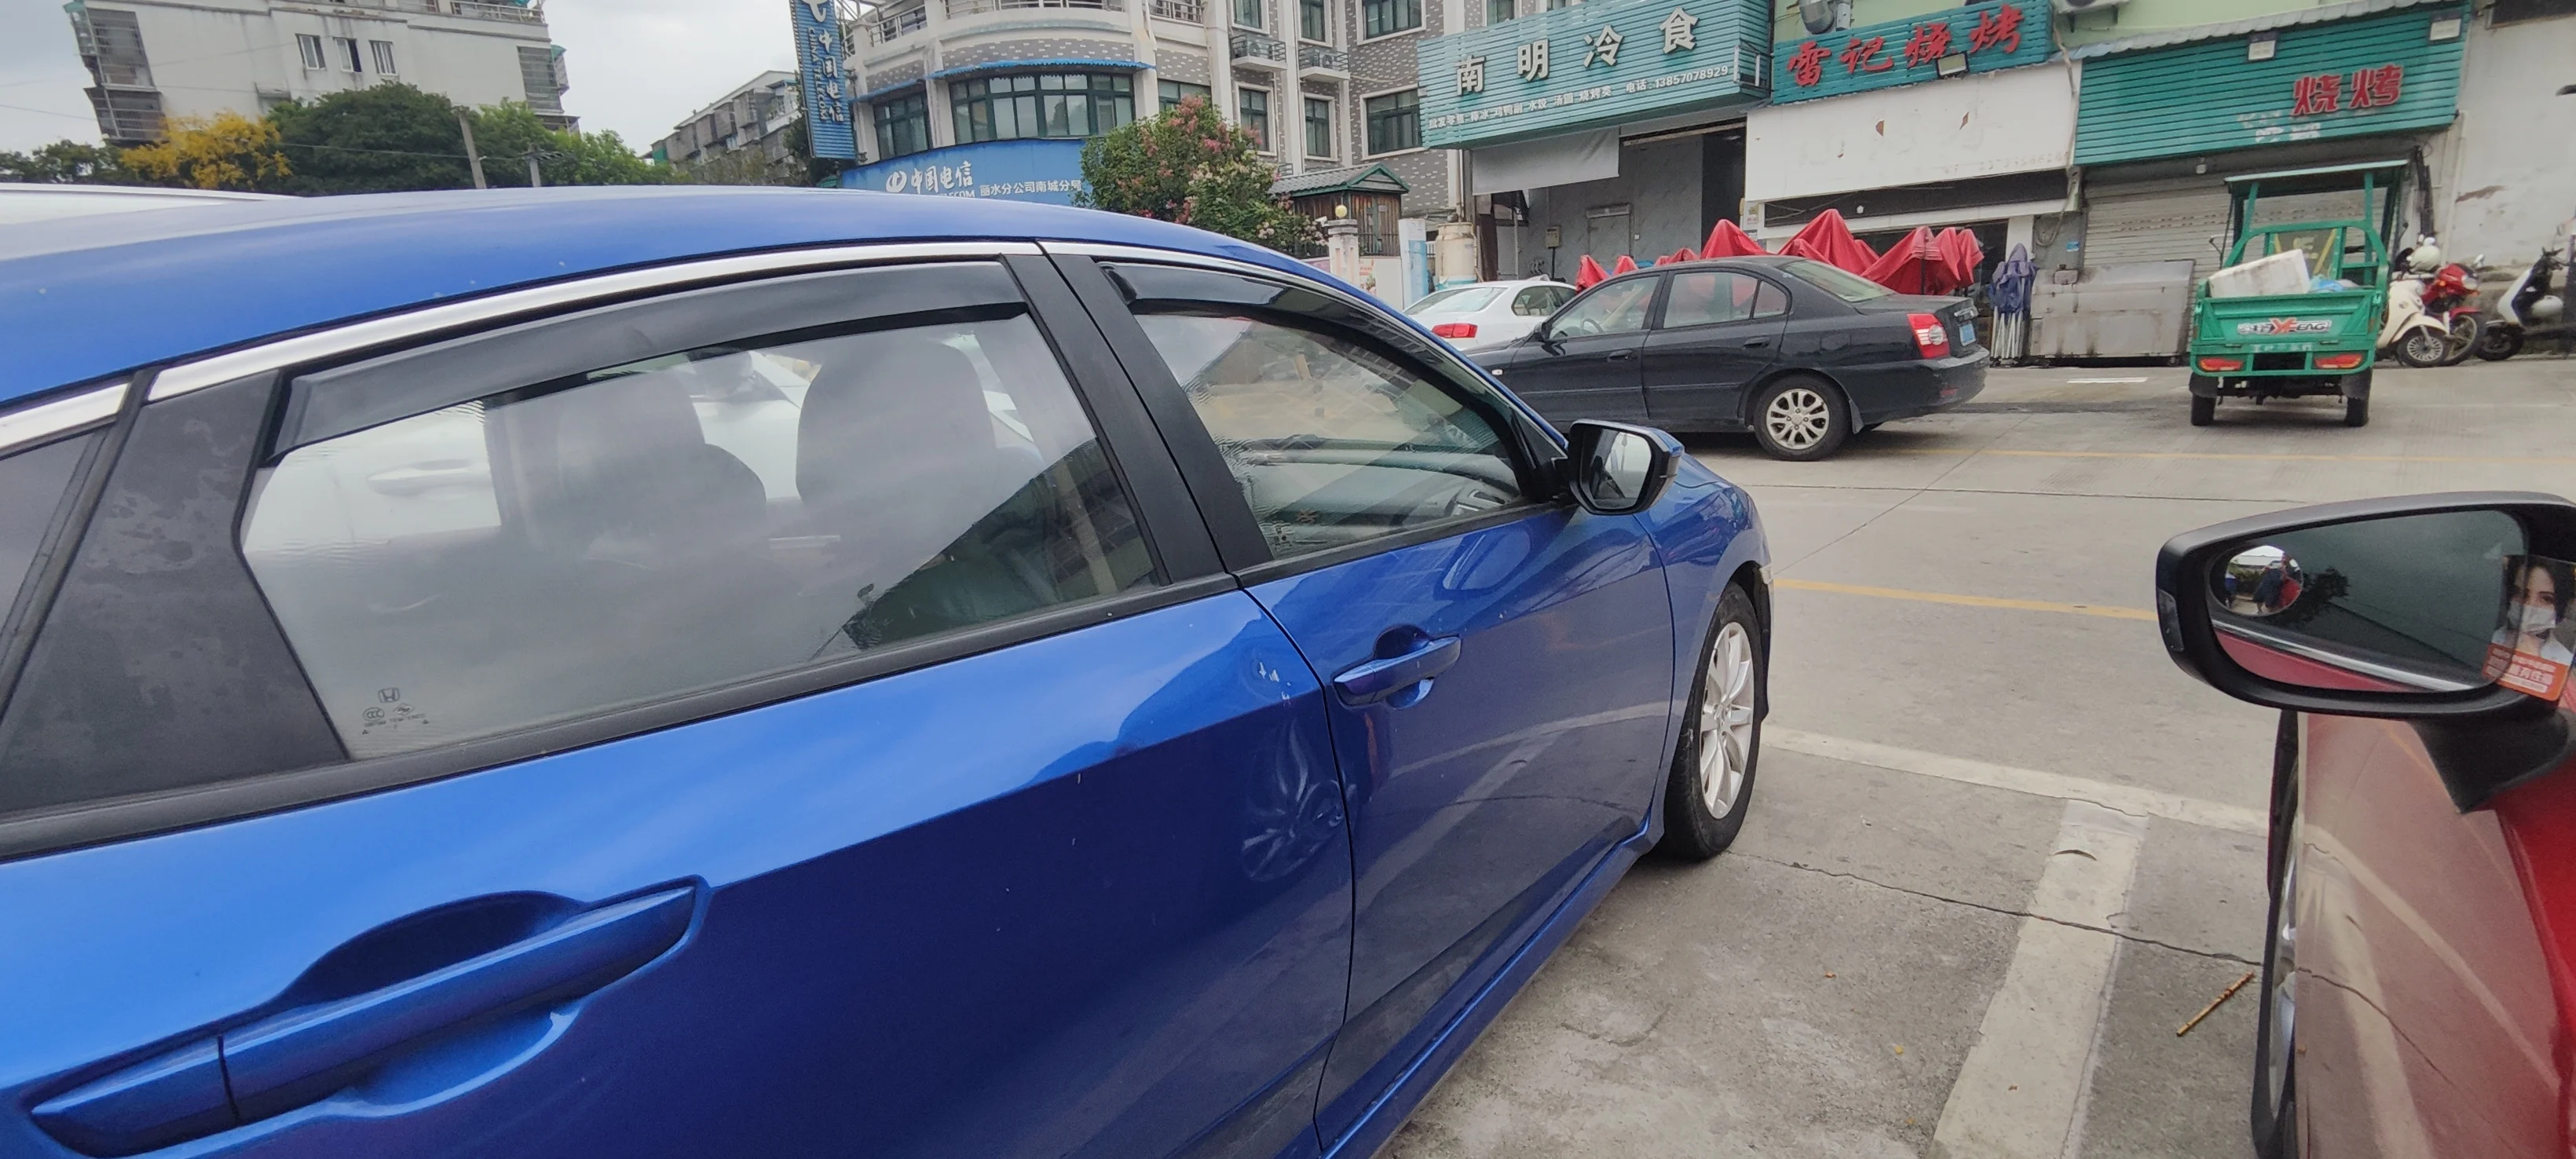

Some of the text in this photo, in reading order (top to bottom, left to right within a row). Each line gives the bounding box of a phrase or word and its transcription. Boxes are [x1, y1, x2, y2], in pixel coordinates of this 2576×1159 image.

[808, 26, 828, 120] CHINA TELECOM
[818, 28, 844, 122] 中国电信
[1454, 6, 1700, 96] 南明冷食
[1787, 4, 2024, 86] 雷记烧烤
[2291, 64, 2402, 115] 烧烤
[911, 160, 974, 194] 中国电信
